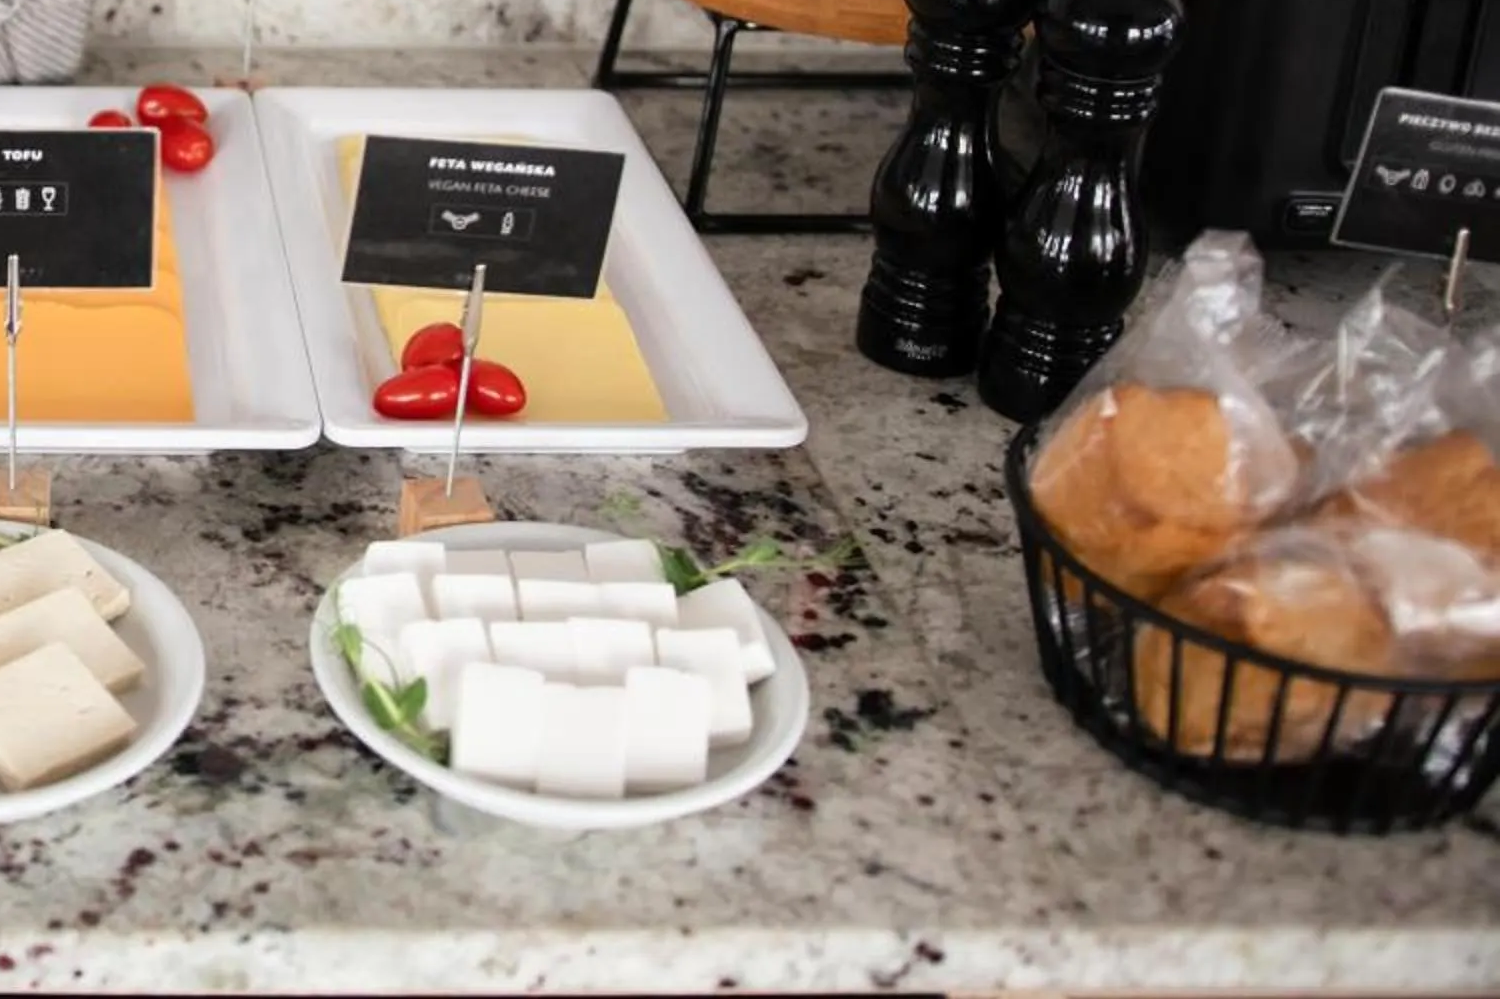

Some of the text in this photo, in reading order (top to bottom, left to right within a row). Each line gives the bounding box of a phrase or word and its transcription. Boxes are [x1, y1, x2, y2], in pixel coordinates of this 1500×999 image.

[2, 150, 43, 161] TOFU
[428, 157, 556, 177] FETA WEGAŃSKA
[428, 179, 551, 198] VEGAN FETA CHEESE
